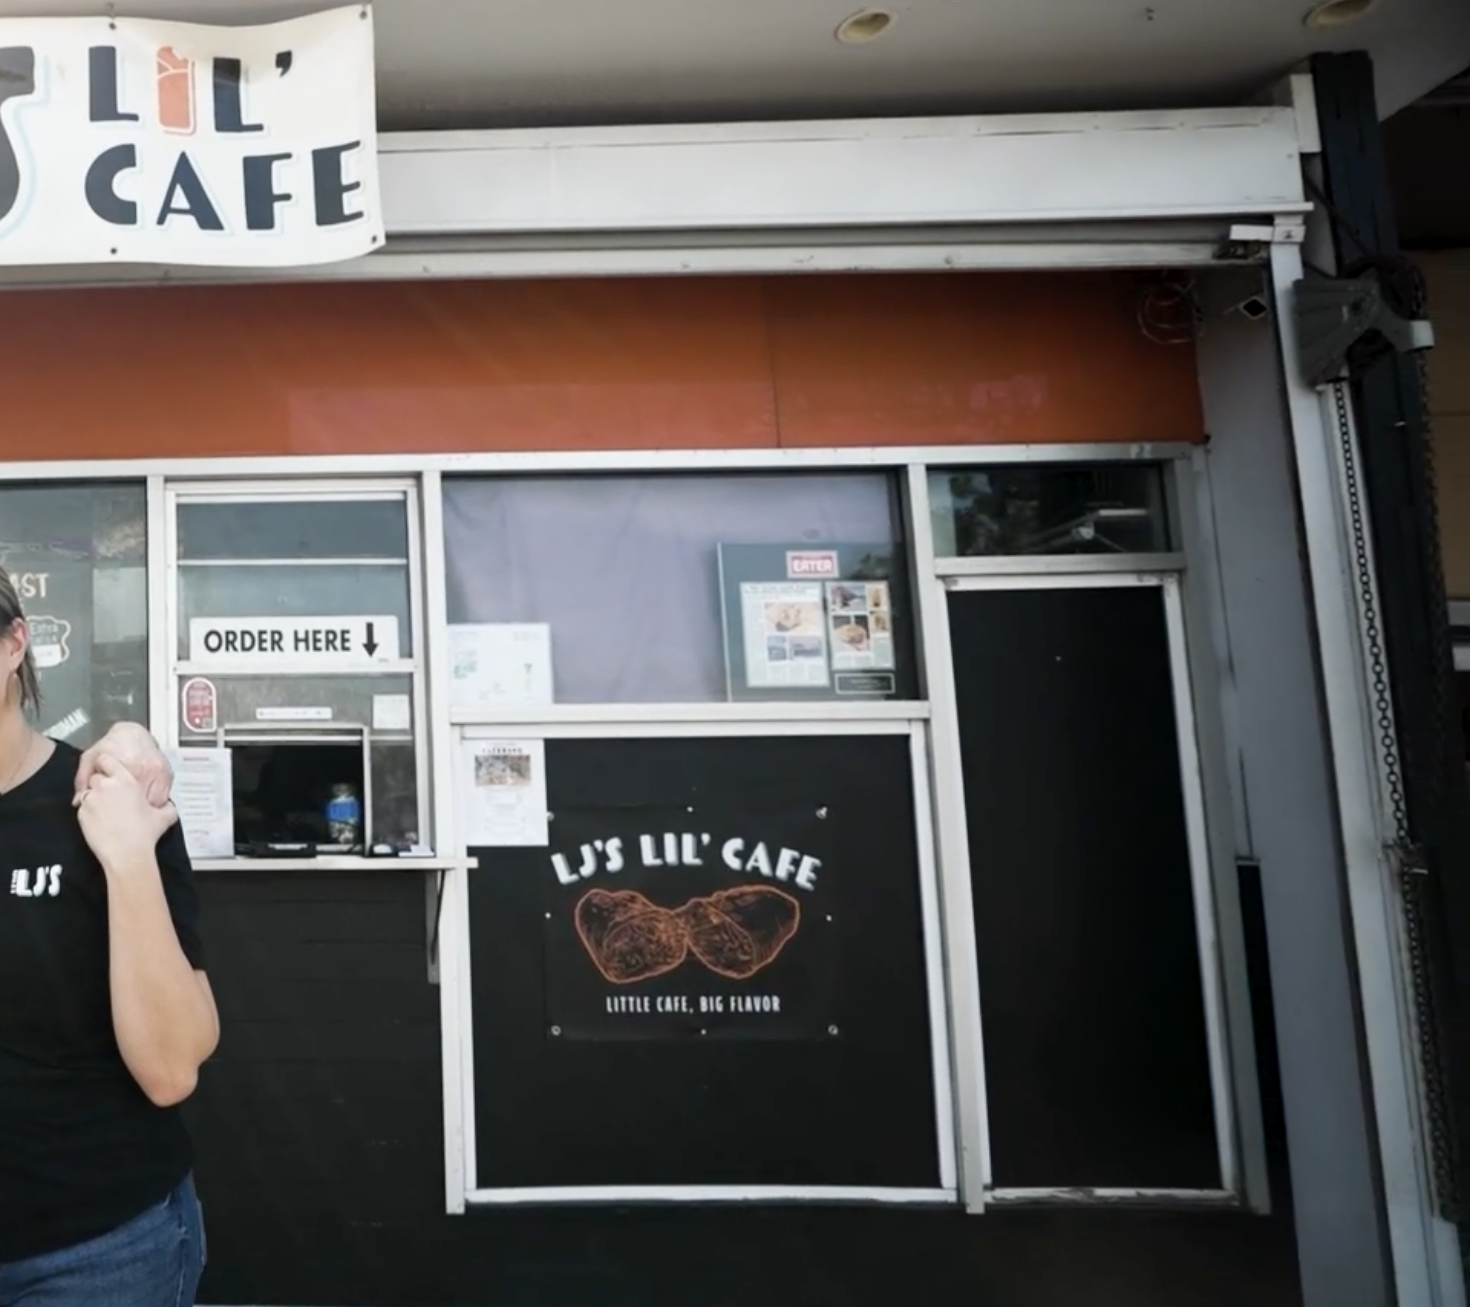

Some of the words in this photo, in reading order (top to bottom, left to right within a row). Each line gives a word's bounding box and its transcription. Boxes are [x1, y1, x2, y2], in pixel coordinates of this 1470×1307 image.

[85, 140, 365, 232] CAFE
[792, 558, 833, 573] EATER
[203, 629, 284, 653] ORDER
[294, 628, 352, 652] HERE
[551, 837, 625, 885] LJ'S
[639, 832, 712, 867] LIL'
[722, 837, 822, 889] CAFE
[15, 863, 63, 897] LJ'S
[606, 996, 650, 1013] LITTLE
[657, 997, 694, 1015] CAFE,
[700, 996, 723, 1012] BIG
[730, 995, 781, 1013] FLAVOR
